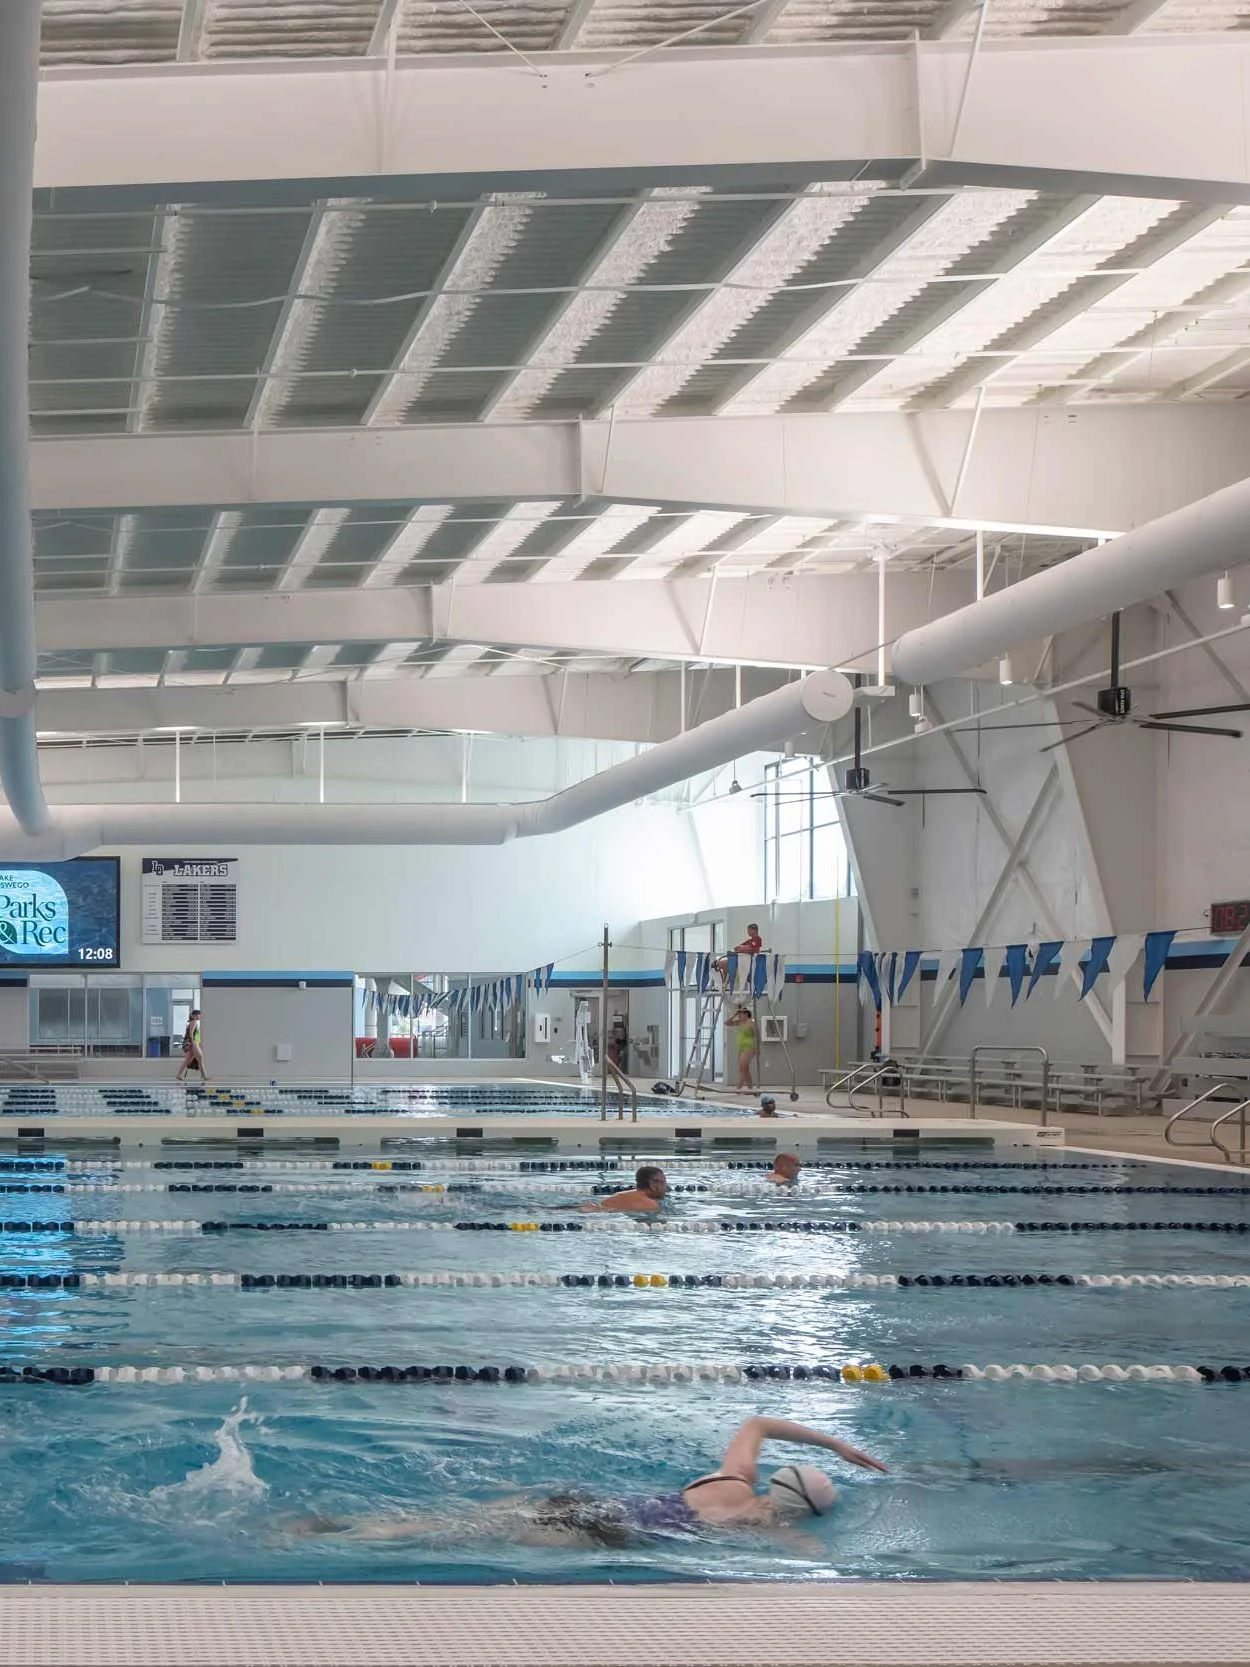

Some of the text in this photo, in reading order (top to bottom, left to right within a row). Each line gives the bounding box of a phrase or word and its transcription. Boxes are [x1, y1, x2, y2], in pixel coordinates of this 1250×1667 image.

[173, 864, 228, 877] LAKERS
[20, 920, 66, 947] Rec
[78, 948, 113, 959] 12:08
